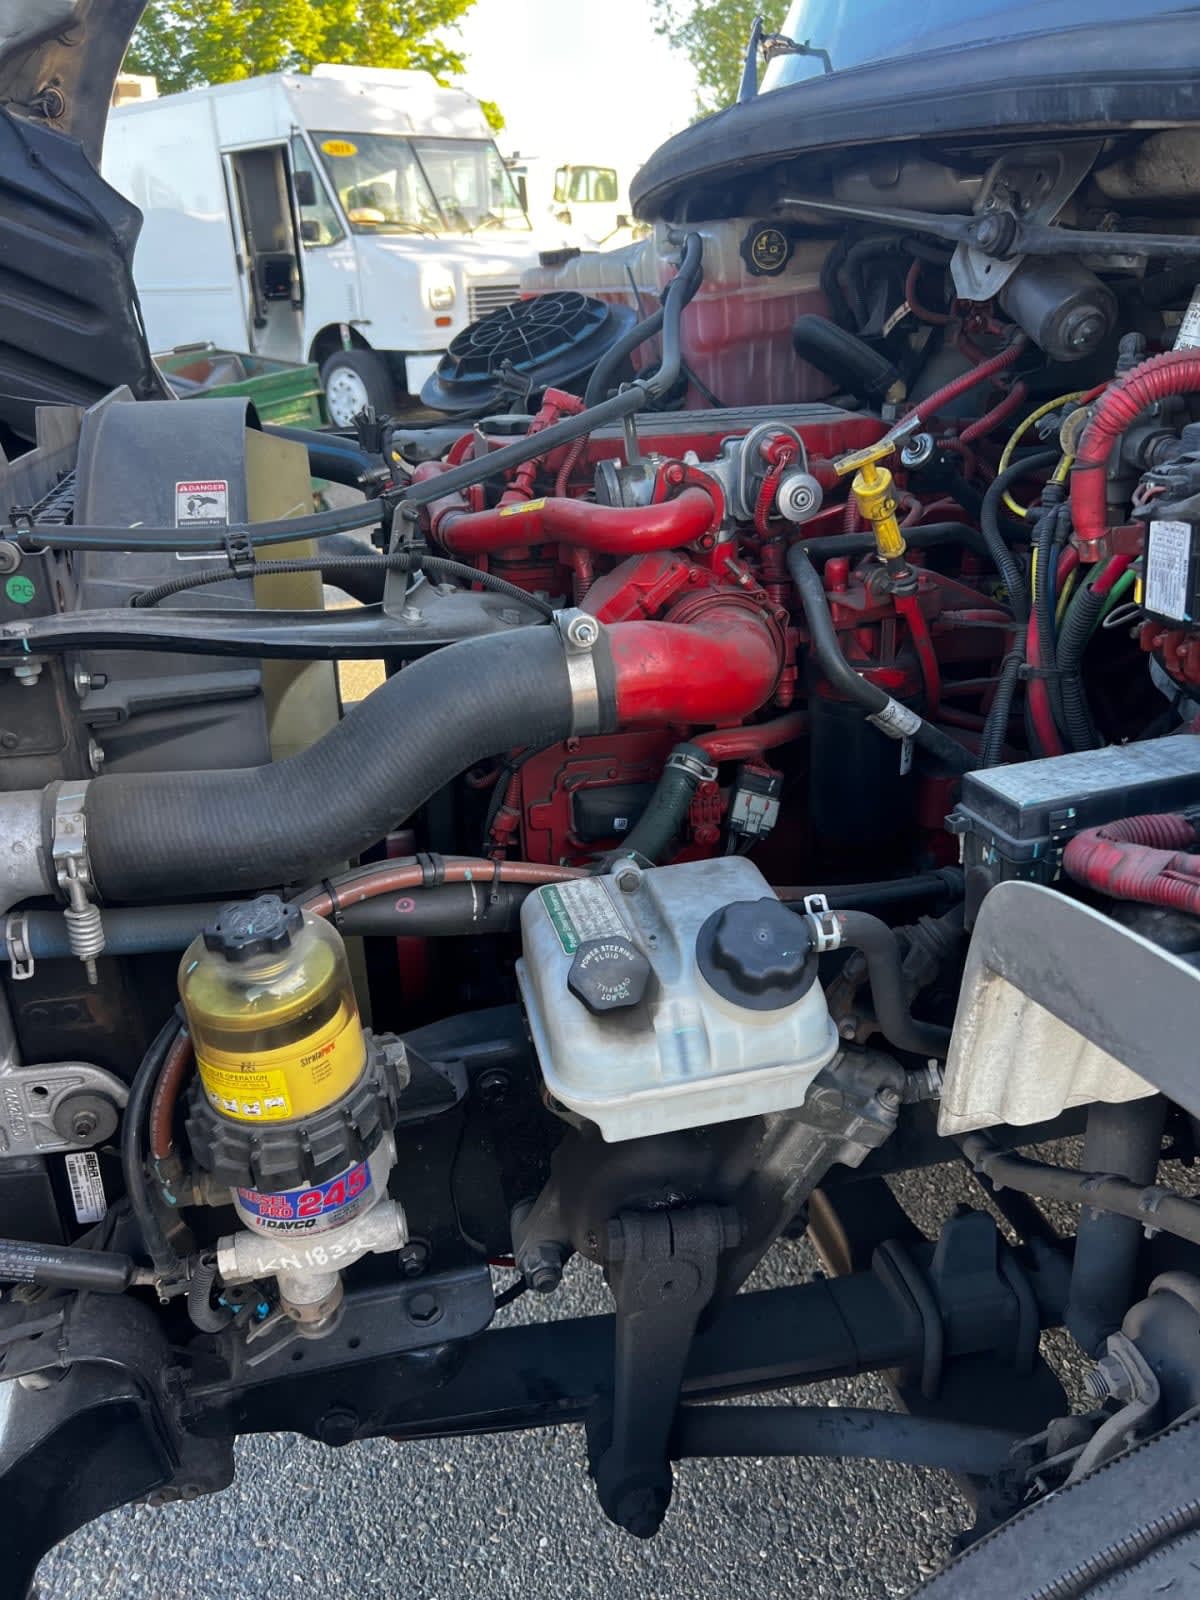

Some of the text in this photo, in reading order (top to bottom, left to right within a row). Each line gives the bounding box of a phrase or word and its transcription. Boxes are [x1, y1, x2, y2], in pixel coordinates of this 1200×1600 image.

[189, 483, 225, 491] DANGER
[580, 945, 635, 969] POWER STEERING
[594, 952, 619, 963] FLUID
[238, 1187, 291, 1206] DIESEL
[297, 1162, 367, 1217] 245
[259, 1203, 293, 1218] PRO
[266, 1218, 317, 1230] DAVCO
